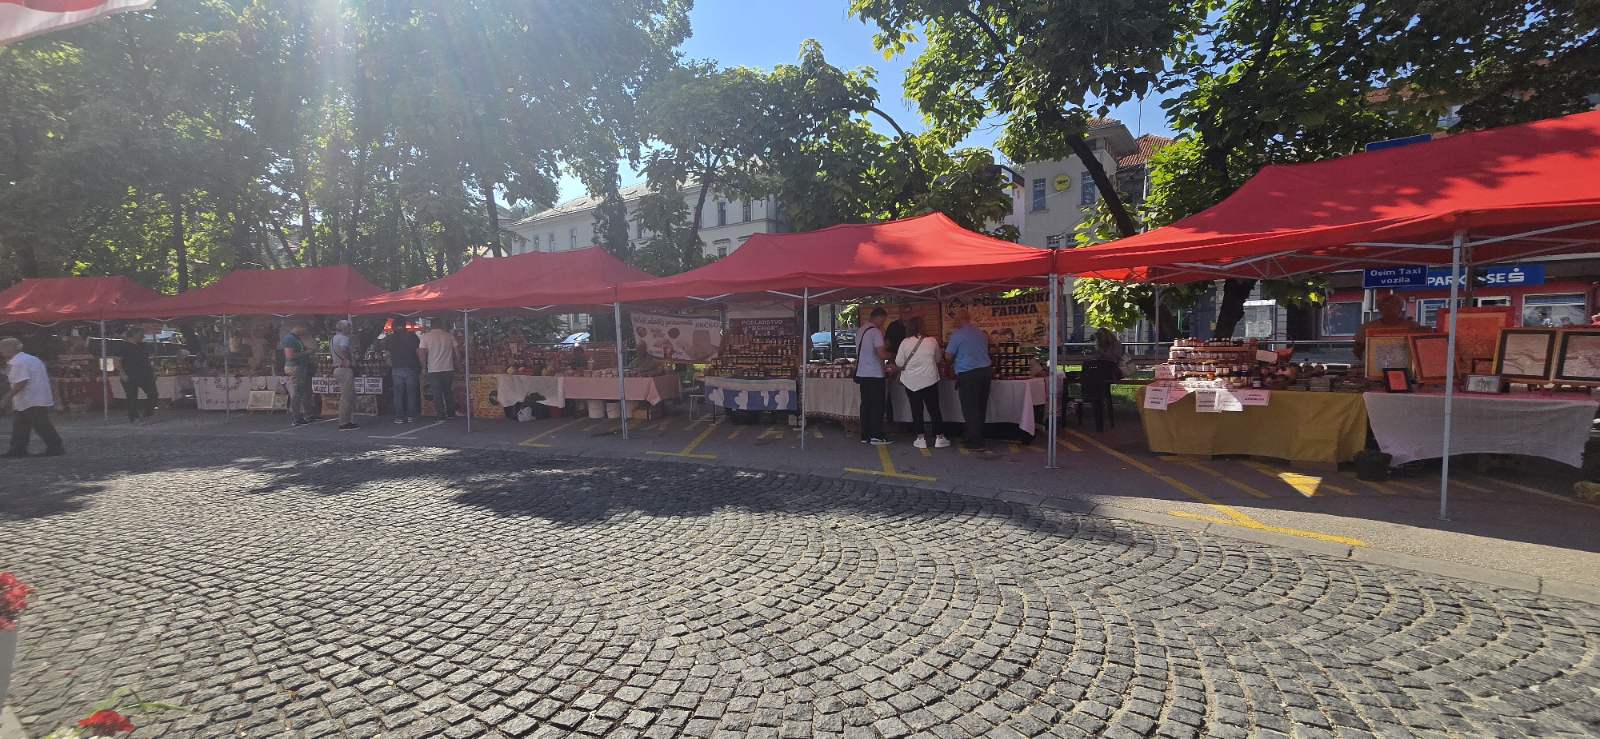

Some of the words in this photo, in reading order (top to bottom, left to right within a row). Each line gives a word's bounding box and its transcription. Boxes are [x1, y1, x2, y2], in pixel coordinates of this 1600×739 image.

[1370, 269, 1396, 277] Osim
[1400, 267, 1421, 275] Taxi
[1381, 276, 1410, 284] vozila
[992, 304, 1039, 317] FARMA
